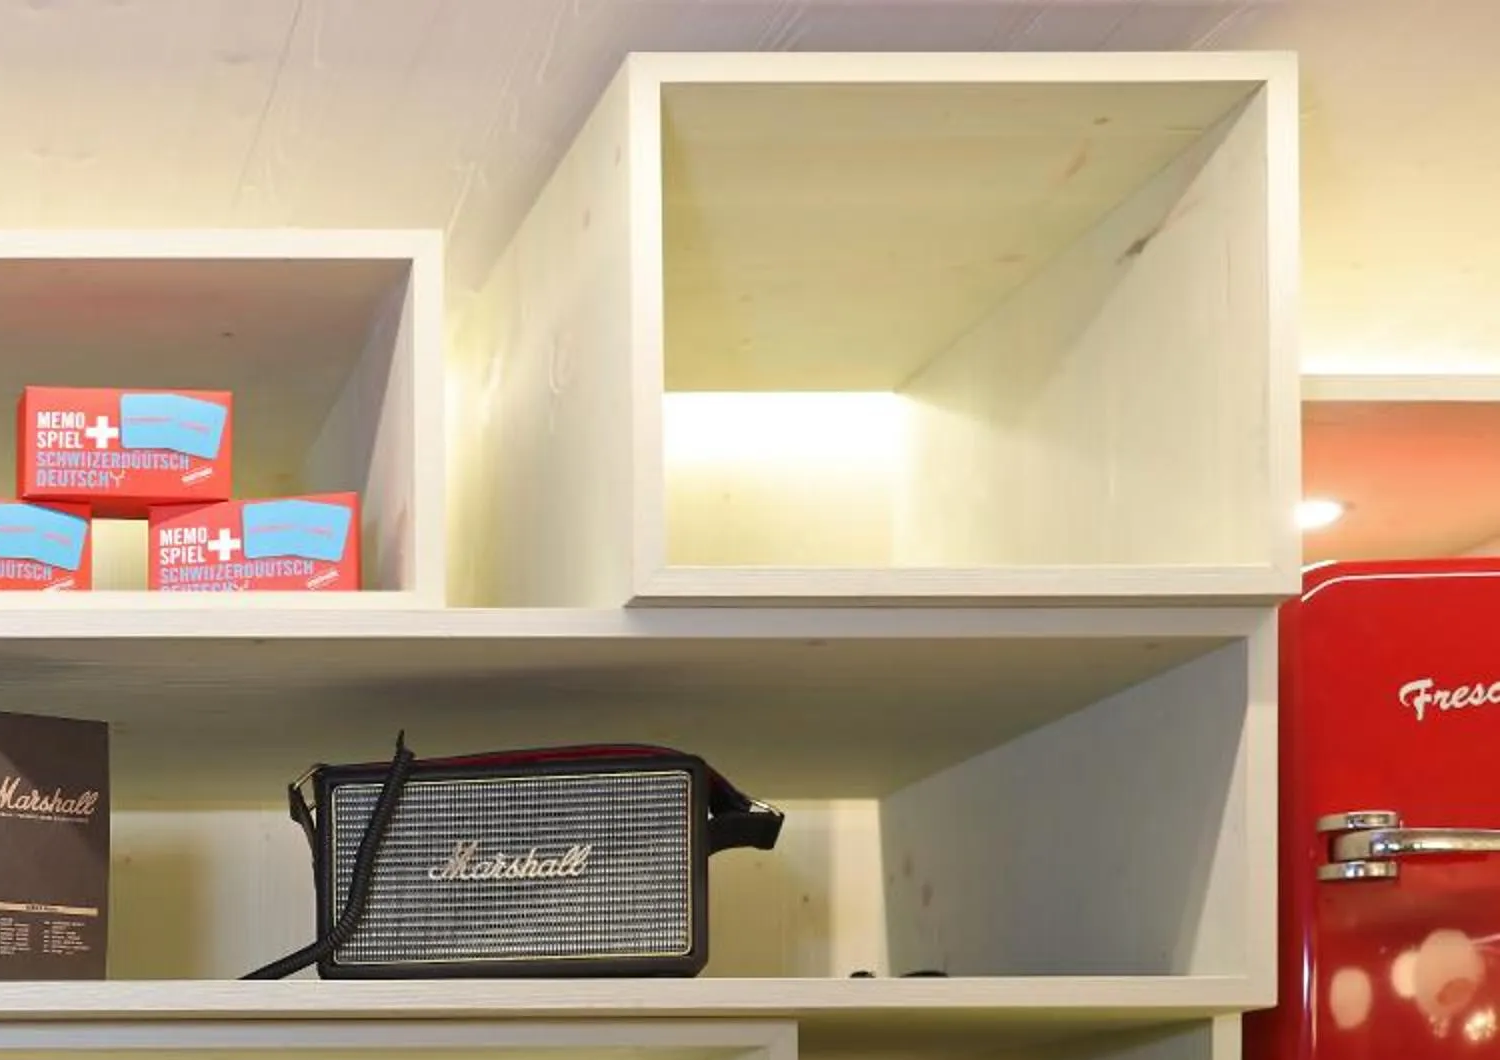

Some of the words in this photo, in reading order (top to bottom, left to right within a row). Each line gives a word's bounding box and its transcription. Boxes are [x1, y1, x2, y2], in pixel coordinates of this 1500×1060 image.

[36, 411, 85, 429] MEMO
[36, 430, 84, 449] SPIEL
[159, 527, 208, 547] MEMO
[160, 545, 206, 565] SPIEL
[428, 840, 592, 879] Marshall
